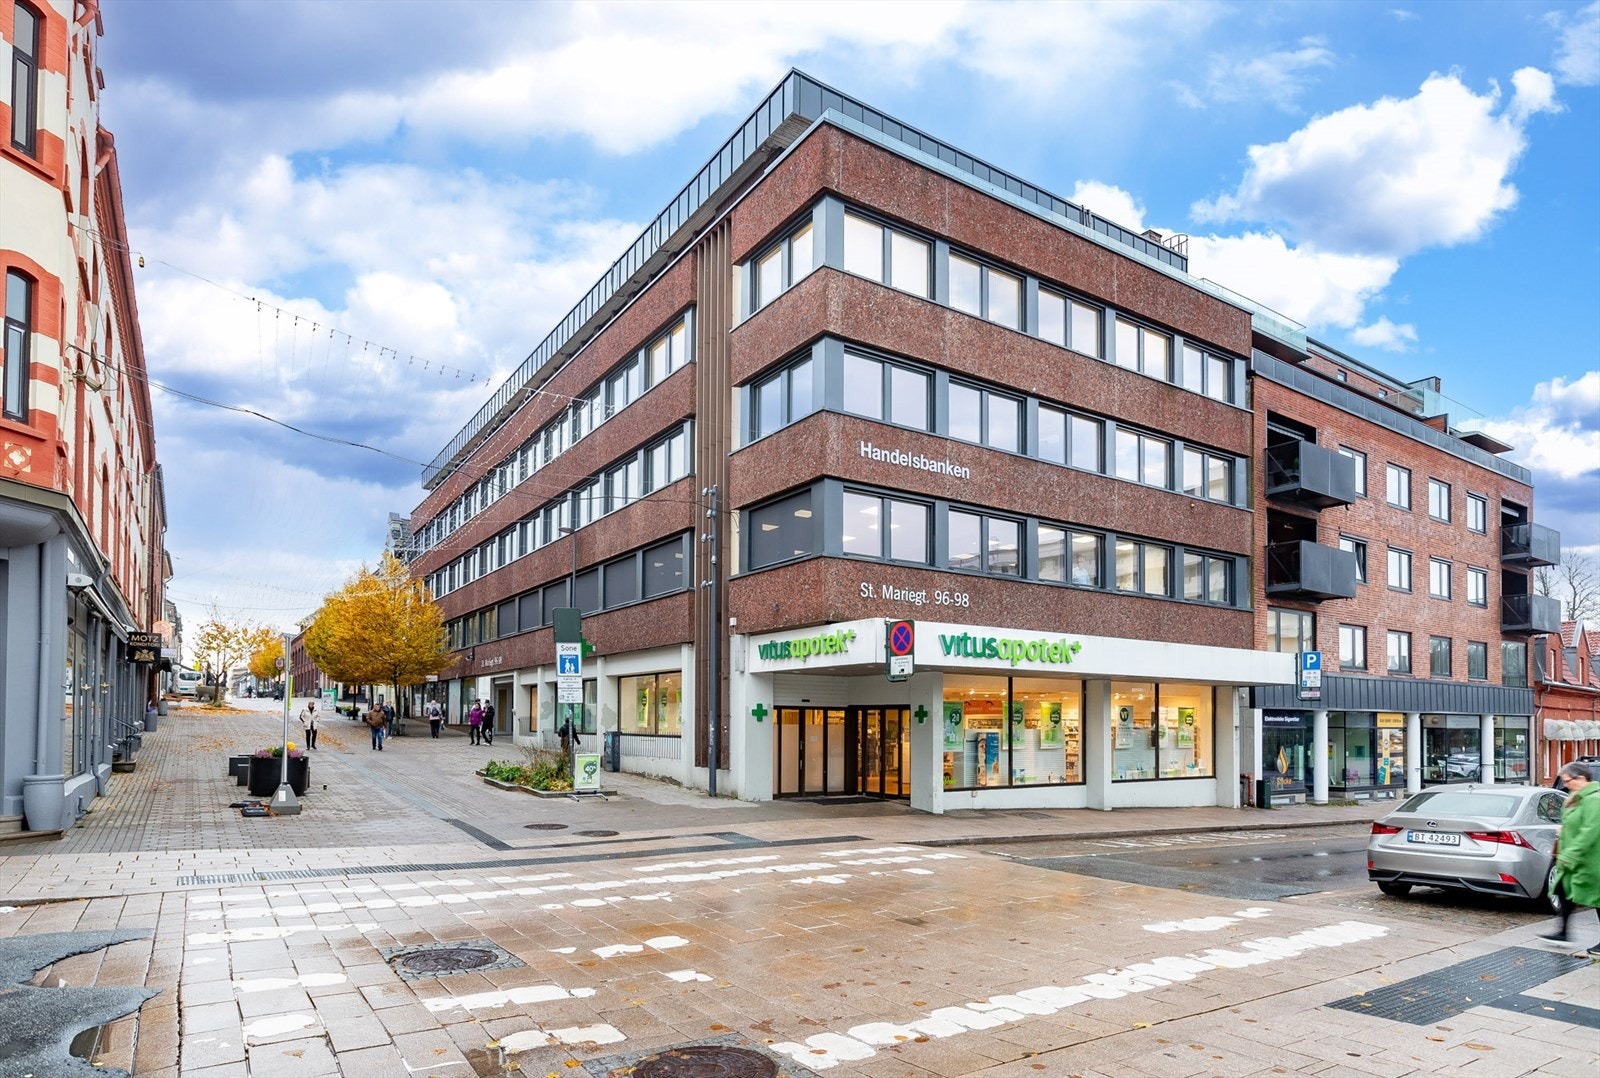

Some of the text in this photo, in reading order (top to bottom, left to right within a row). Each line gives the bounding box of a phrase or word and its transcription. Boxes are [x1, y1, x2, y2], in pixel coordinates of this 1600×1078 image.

[860, 440, 970, 479] Handelsbanken
[860, 582, 970, 608] St. Mariegt. 96-98
[131, 634, 159, 642] MOTZ
[1306, 654, 1317, 669] P
[1414, 833, 1457, 844] BT 42493
